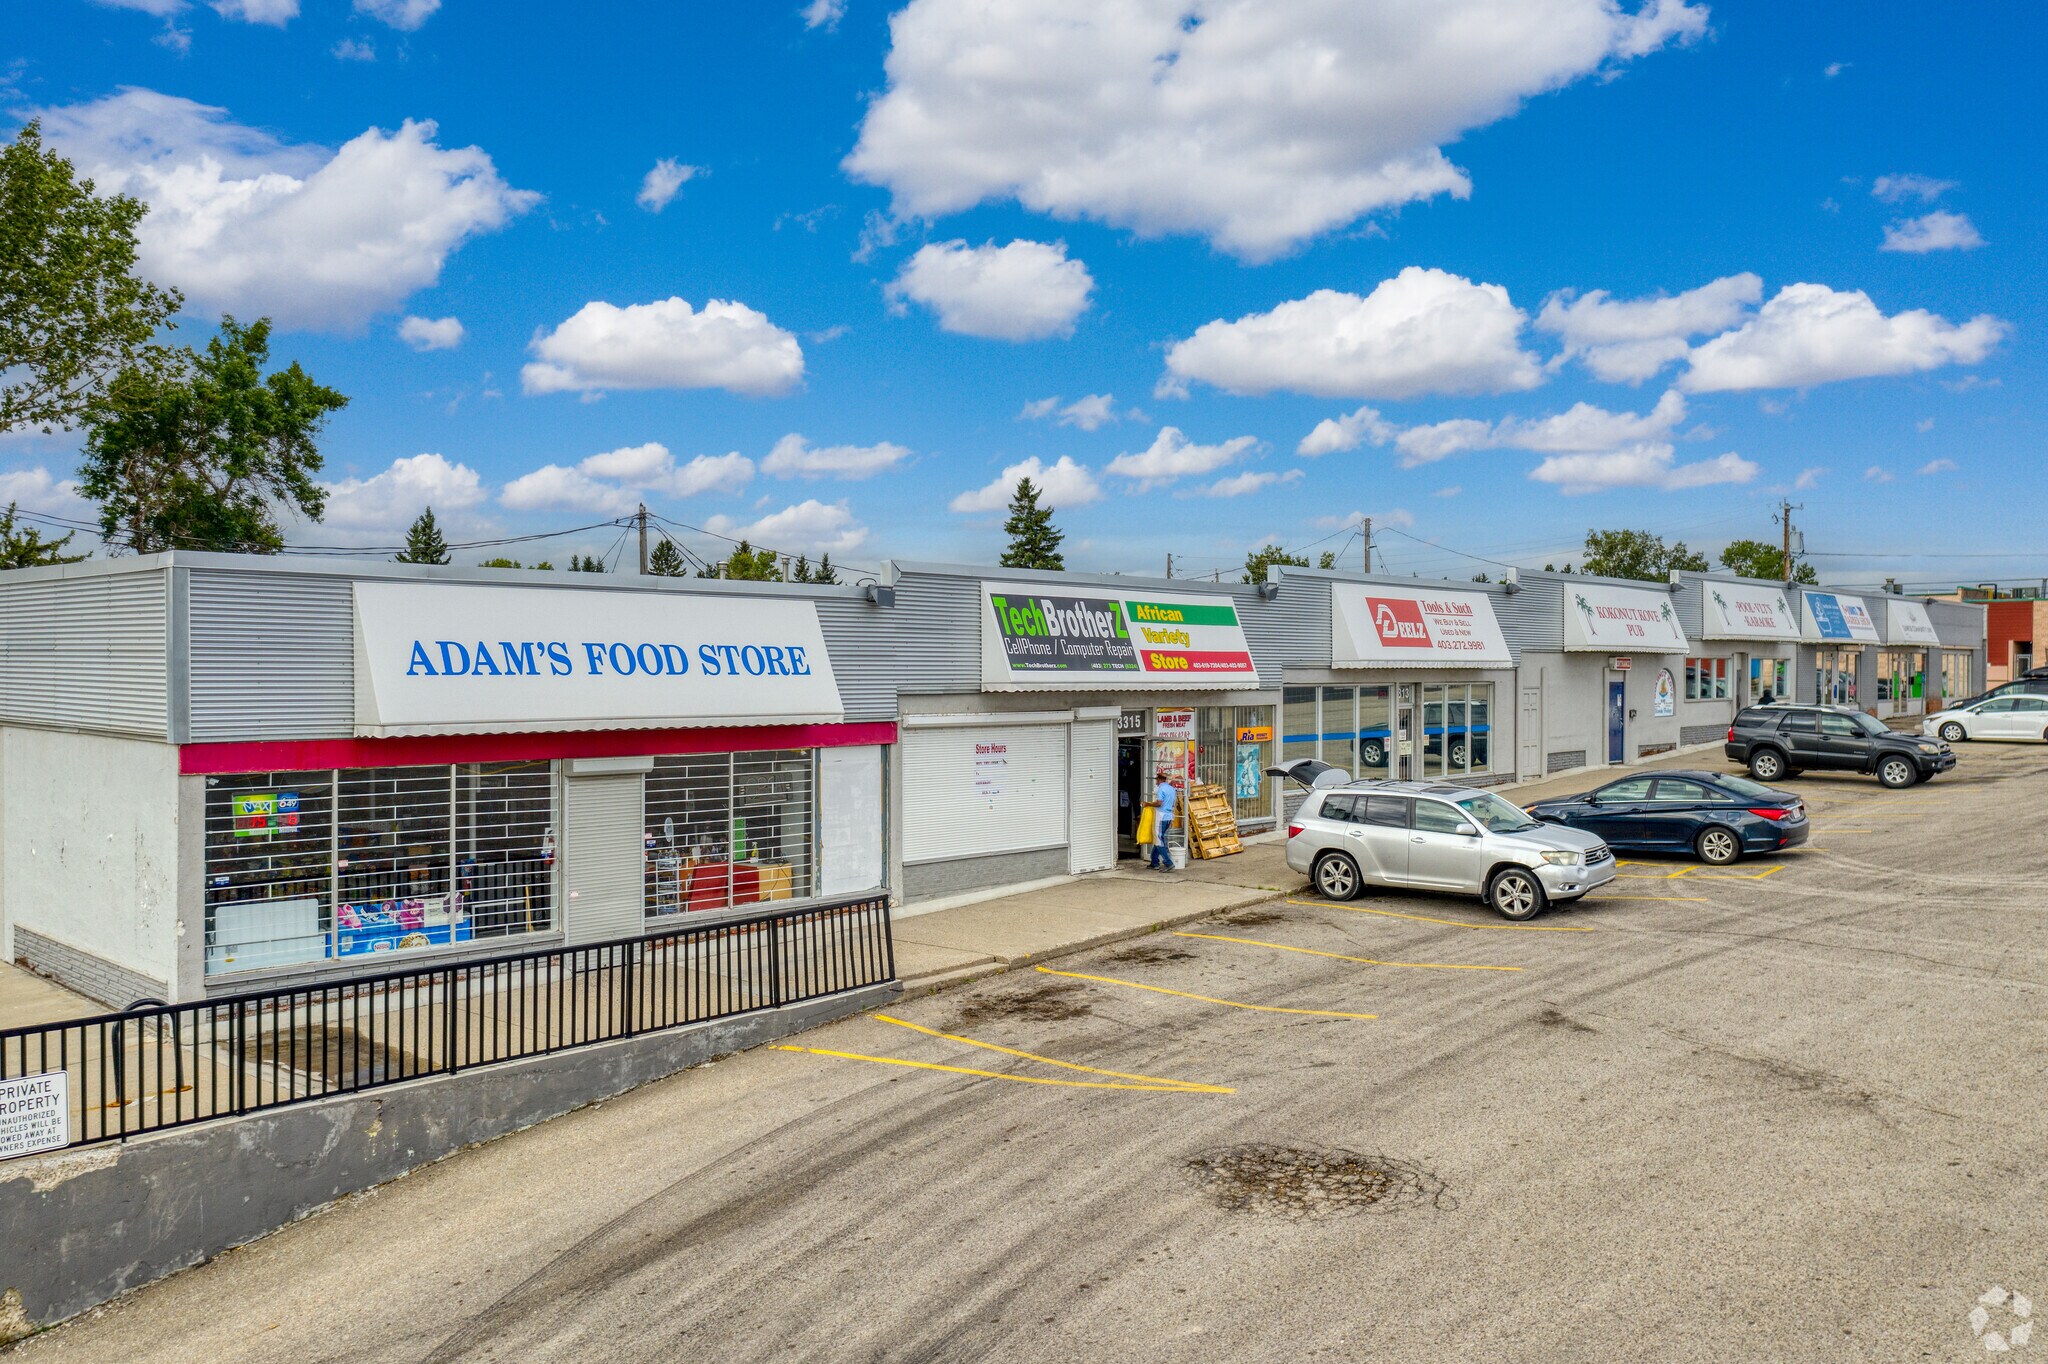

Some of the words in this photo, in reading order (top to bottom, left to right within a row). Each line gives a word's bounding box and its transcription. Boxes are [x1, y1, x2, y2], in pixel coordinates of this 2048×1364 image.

[1137, 604, 1184, 623] African
[1420, 600, 1445, 614] Tools
[1445, 602, 1451, 614] &
[1451, 601, 1473, 615] Such
[1596, 606, 1638, 621] KOKONUT
[1637, 609, 1661, 622] KOVE
[993, 597, 1129, 639] TechBrotherZ
[1142, 627, 1190, 648] Variety
[1626, 624, 1645, 637] PUB
[1004, 638, 1052, 655] CellPhone
[1060, 639, 1104, 659] Computer
[1105, 640, 1134, 659] Repair
[1437, 640, 1486, 650] 403.272.9981
[406, 639, 573, 676] ADAM'S
[581, 642, 689, 676] FOOD
[700, 644, 812, 676] STORE
[1151, 652, 1189, 670] Store
[1398, 688, 1410, 699] 313
[1117, 714, 1141, 730] 3315
[1157, 715, 1172, 723] LAMB
[1178, 714, 1192, 722] BEEF
[1242, 730, 1255, 741] Ria
[976, 744, 990, 754] Store
[991, 743, 1007, 753] Hours
[0, 1081, 51, 1099] PRIVATE
[0, 1094, 60, 1115] ROPERTY
[0, 1109, 56, 1126] NAUTHORIZED
[0, 1124, 28, 1135] HICLES
[31, 1120, 49, 1129] WILL
[52, 1117, 61, 1126] BE
[0, 1133, 22, 1144] OWED
[25, 1130, 45, 1140] AWAY
[47, 1127, 56, 1135] AT
[0, 1142, 24, 1153] WNERS
[27, 1135, 61, 1148] EXPENSE
